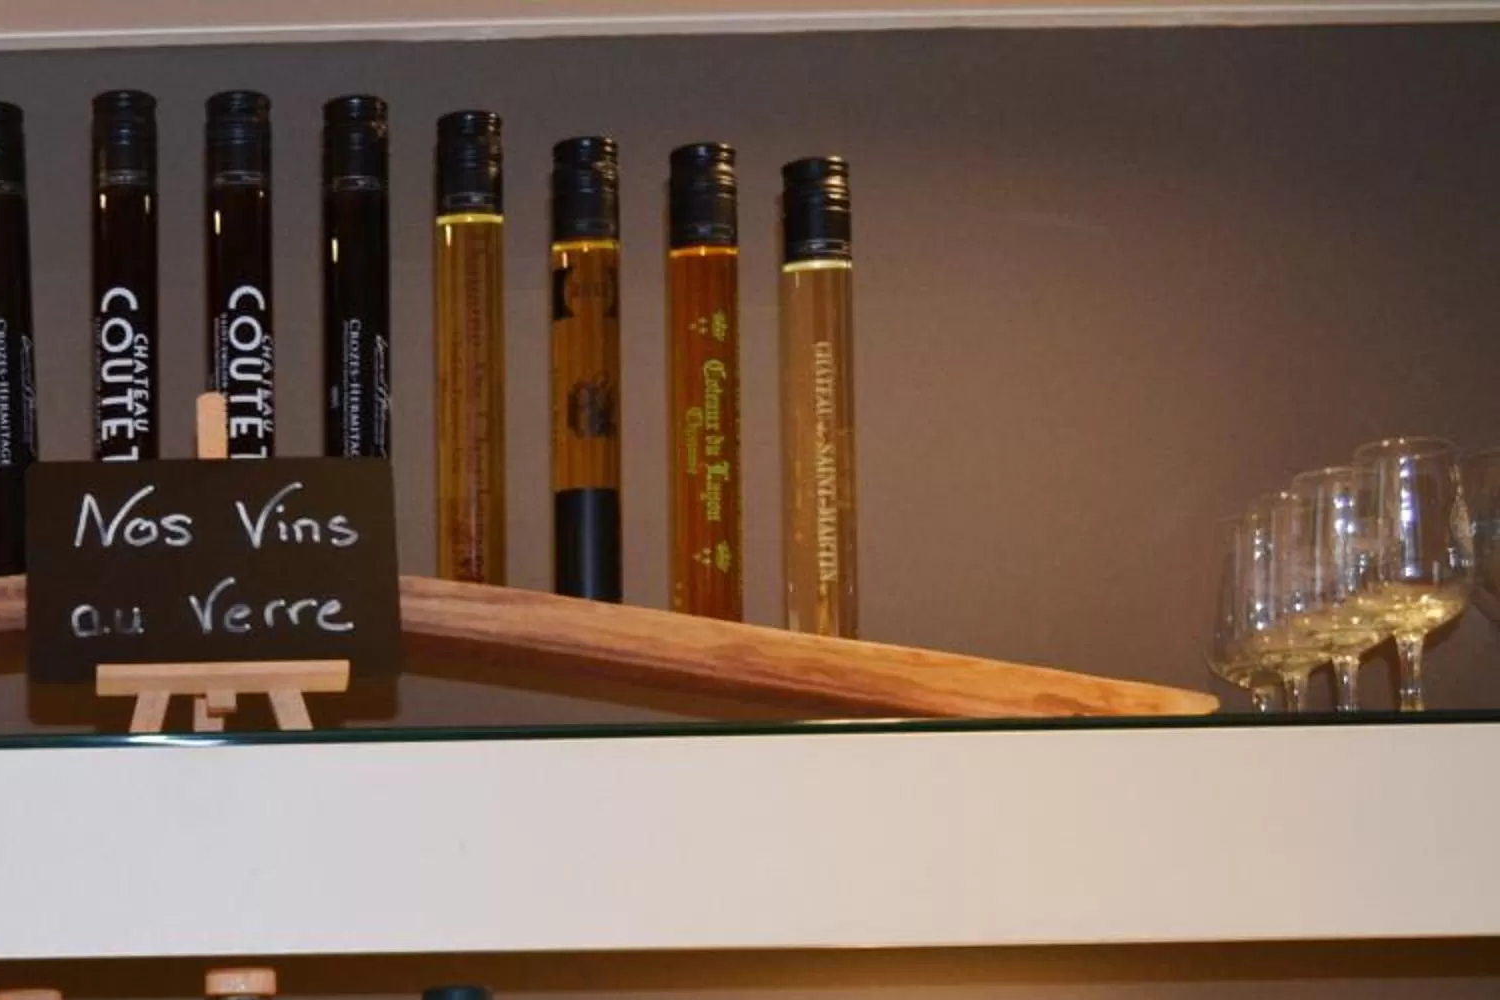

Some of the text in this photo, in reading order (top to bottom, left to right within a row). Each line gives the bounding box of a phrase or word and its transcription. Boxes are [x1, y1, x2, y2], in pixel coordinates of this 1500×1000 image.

[132, 333, 150, 433] CHATEAU
[260, 333, 275, 433] CHATEAU
[348, 318, 364, 457] CROZES-HERMITAG
[73, 481, 360, 549] Nos Vins
[815, 441, 838, 583] SAINT-MARTIN
[70, 576, 356, 638] au Verre
